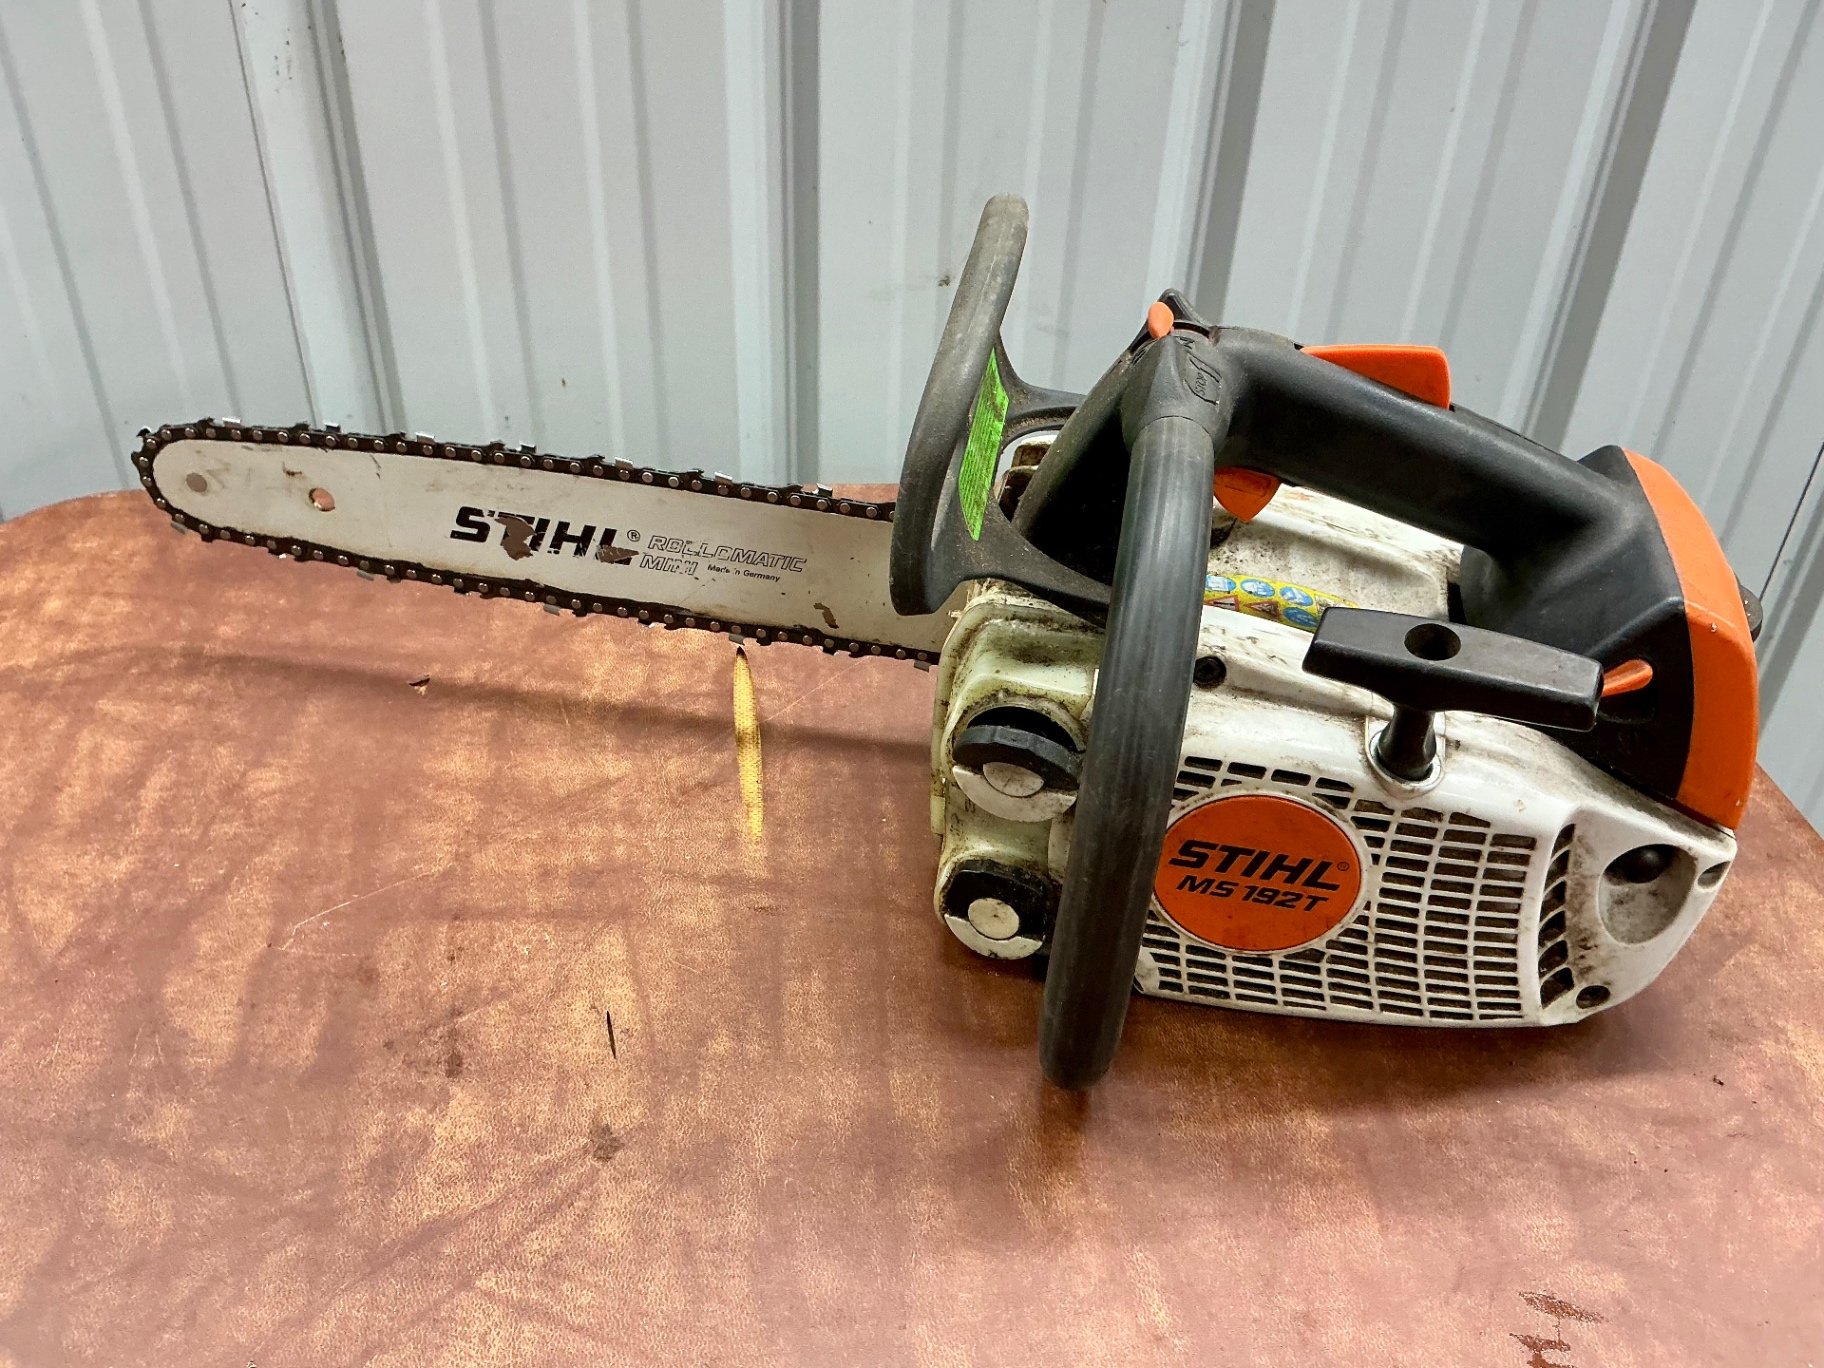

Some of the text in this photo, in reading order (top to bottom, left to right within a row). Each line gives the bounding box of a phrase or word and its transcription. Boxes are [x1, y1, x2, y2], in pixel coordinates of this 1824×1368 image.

[647, 535, 808, 573] ROLLOMATIC
[743, 568, 781, 583] Germany
[1168, 839, 1341, 892] STIHL
[1176, 875, 1330, 912] MS 192T
